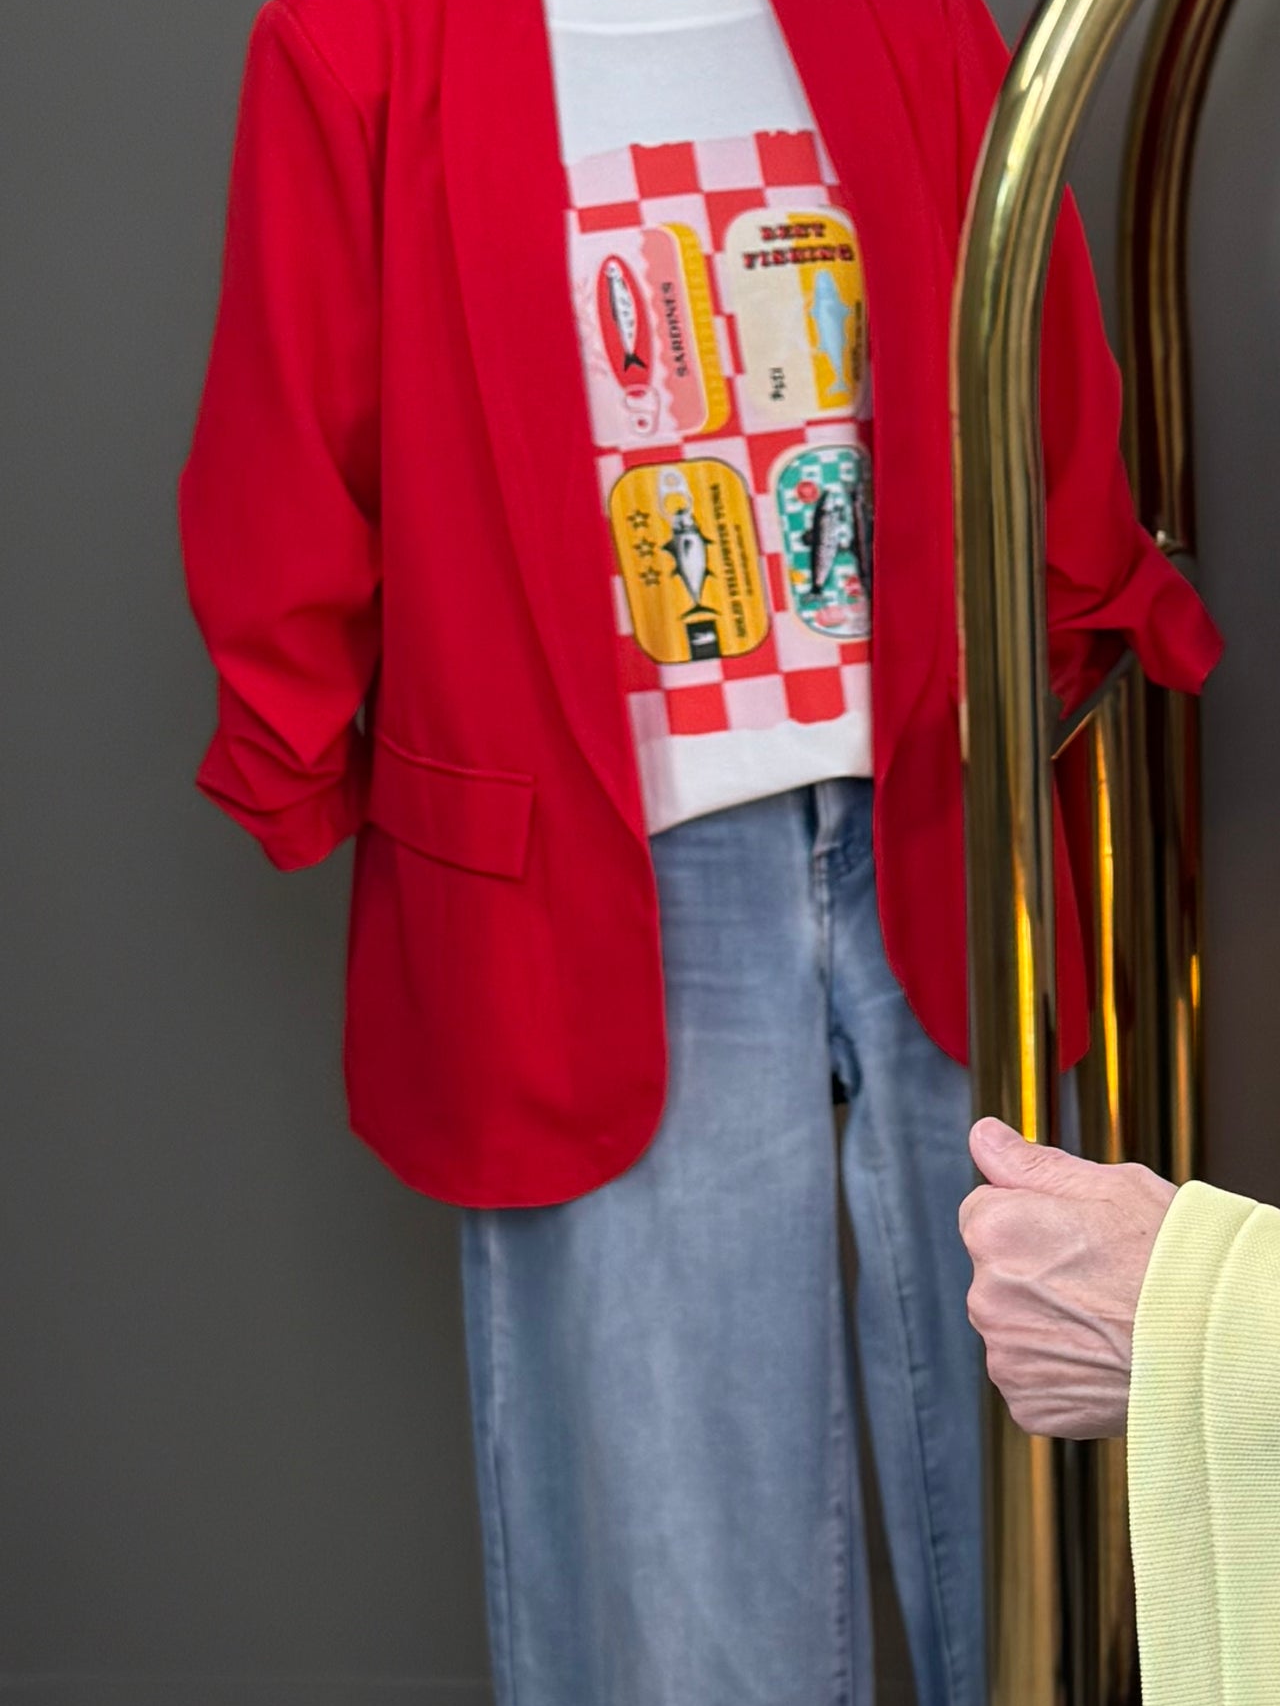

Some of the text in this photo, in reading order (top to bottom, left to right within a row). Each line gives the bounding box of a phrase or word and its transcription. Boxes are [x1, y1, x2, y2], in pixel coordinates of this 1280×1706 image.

[760, 223, 825, 241] BEST
[743, 244, 854, 270] FISHING
[661, 281, 688, 378] SARDINES
